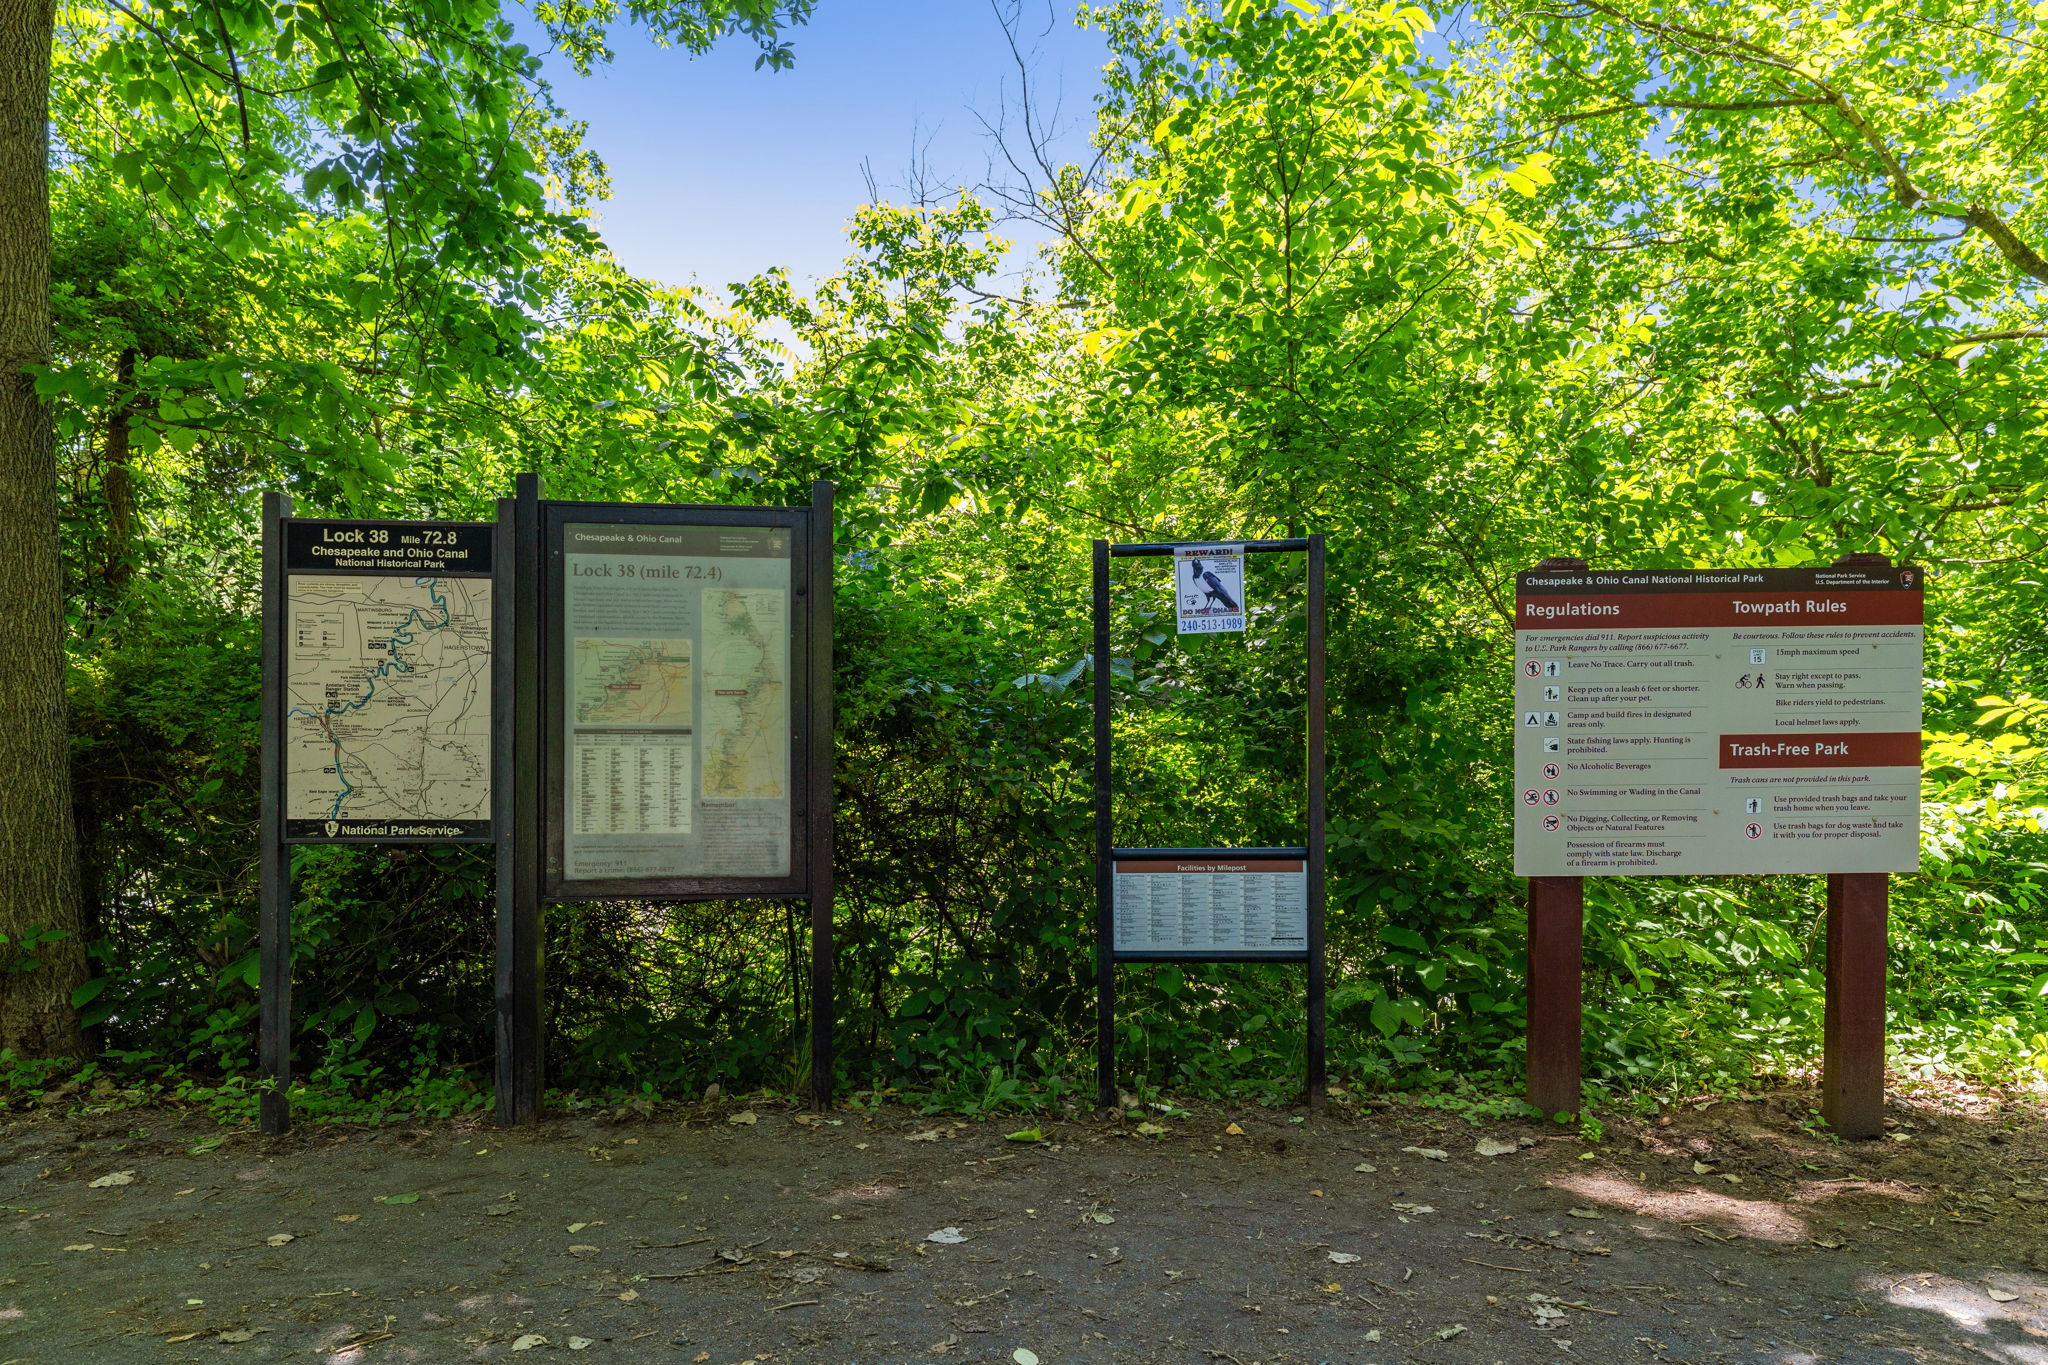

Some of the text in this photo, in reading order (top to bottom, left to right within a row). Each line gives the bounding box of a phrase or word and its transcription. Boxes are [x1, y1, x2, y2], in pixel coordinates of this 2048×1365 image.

[323, 529, 389, 544] Lock 38
[401, 531, 457, 545] Mile 72.8
[575, 534, 625, 542] Chesapeake
[312, 546, 468, 558] Chesapeake and Ohio Canal
[336, 559, 374, 567] National
[377, 560, 422, 568] Historical
[573, 563, 722, 581] Lock 38 (mile 72.4)
[1526, 577, 1583, 586] Chesapeake
[1596, 576, 1619, 584] Ohio
[1622, 576, 1649, 584] Canal
[1652, 576, 1693, 584] National
[1695, 575, 1740, 583] Historical
[1743, 574, 1764, 583] Park
[1526, 603, 1620, 619] Regulations
[1733, 600, 1847, 616] Towpath Rules
[1182, 618, 1242, 631] 240-513-1989
[1618, 634, 1642, 642] Report
[1568, 645, 1598, 653] Rangers
[1599, 644, 1608, 652] by
[1609, 644, 1634, 652] calling
[1776, 649, 1801, 657] 15mph
[1839, 648, 1860, 656] speed
[1775, 673, 1790, 681] Stay
[1792, 673, 1809, 681] right
[1568, 686, 1587, 694] Keep
[1568, 712, 1590, 720] Camp
[1588, 721, 1606, 729] only.
[1840, 718, 1861, 727] apply.
[1587, 737, 1612, 745] fishing
[1630, 737, 1652, 745] apply.
[1730, 742, 1848, 756] Trash-Free Park
[1788, 796, 1821, 804] provided
[1842, 795, 1858, 803] bags
[342, 826, 460, 835] National Park Service
